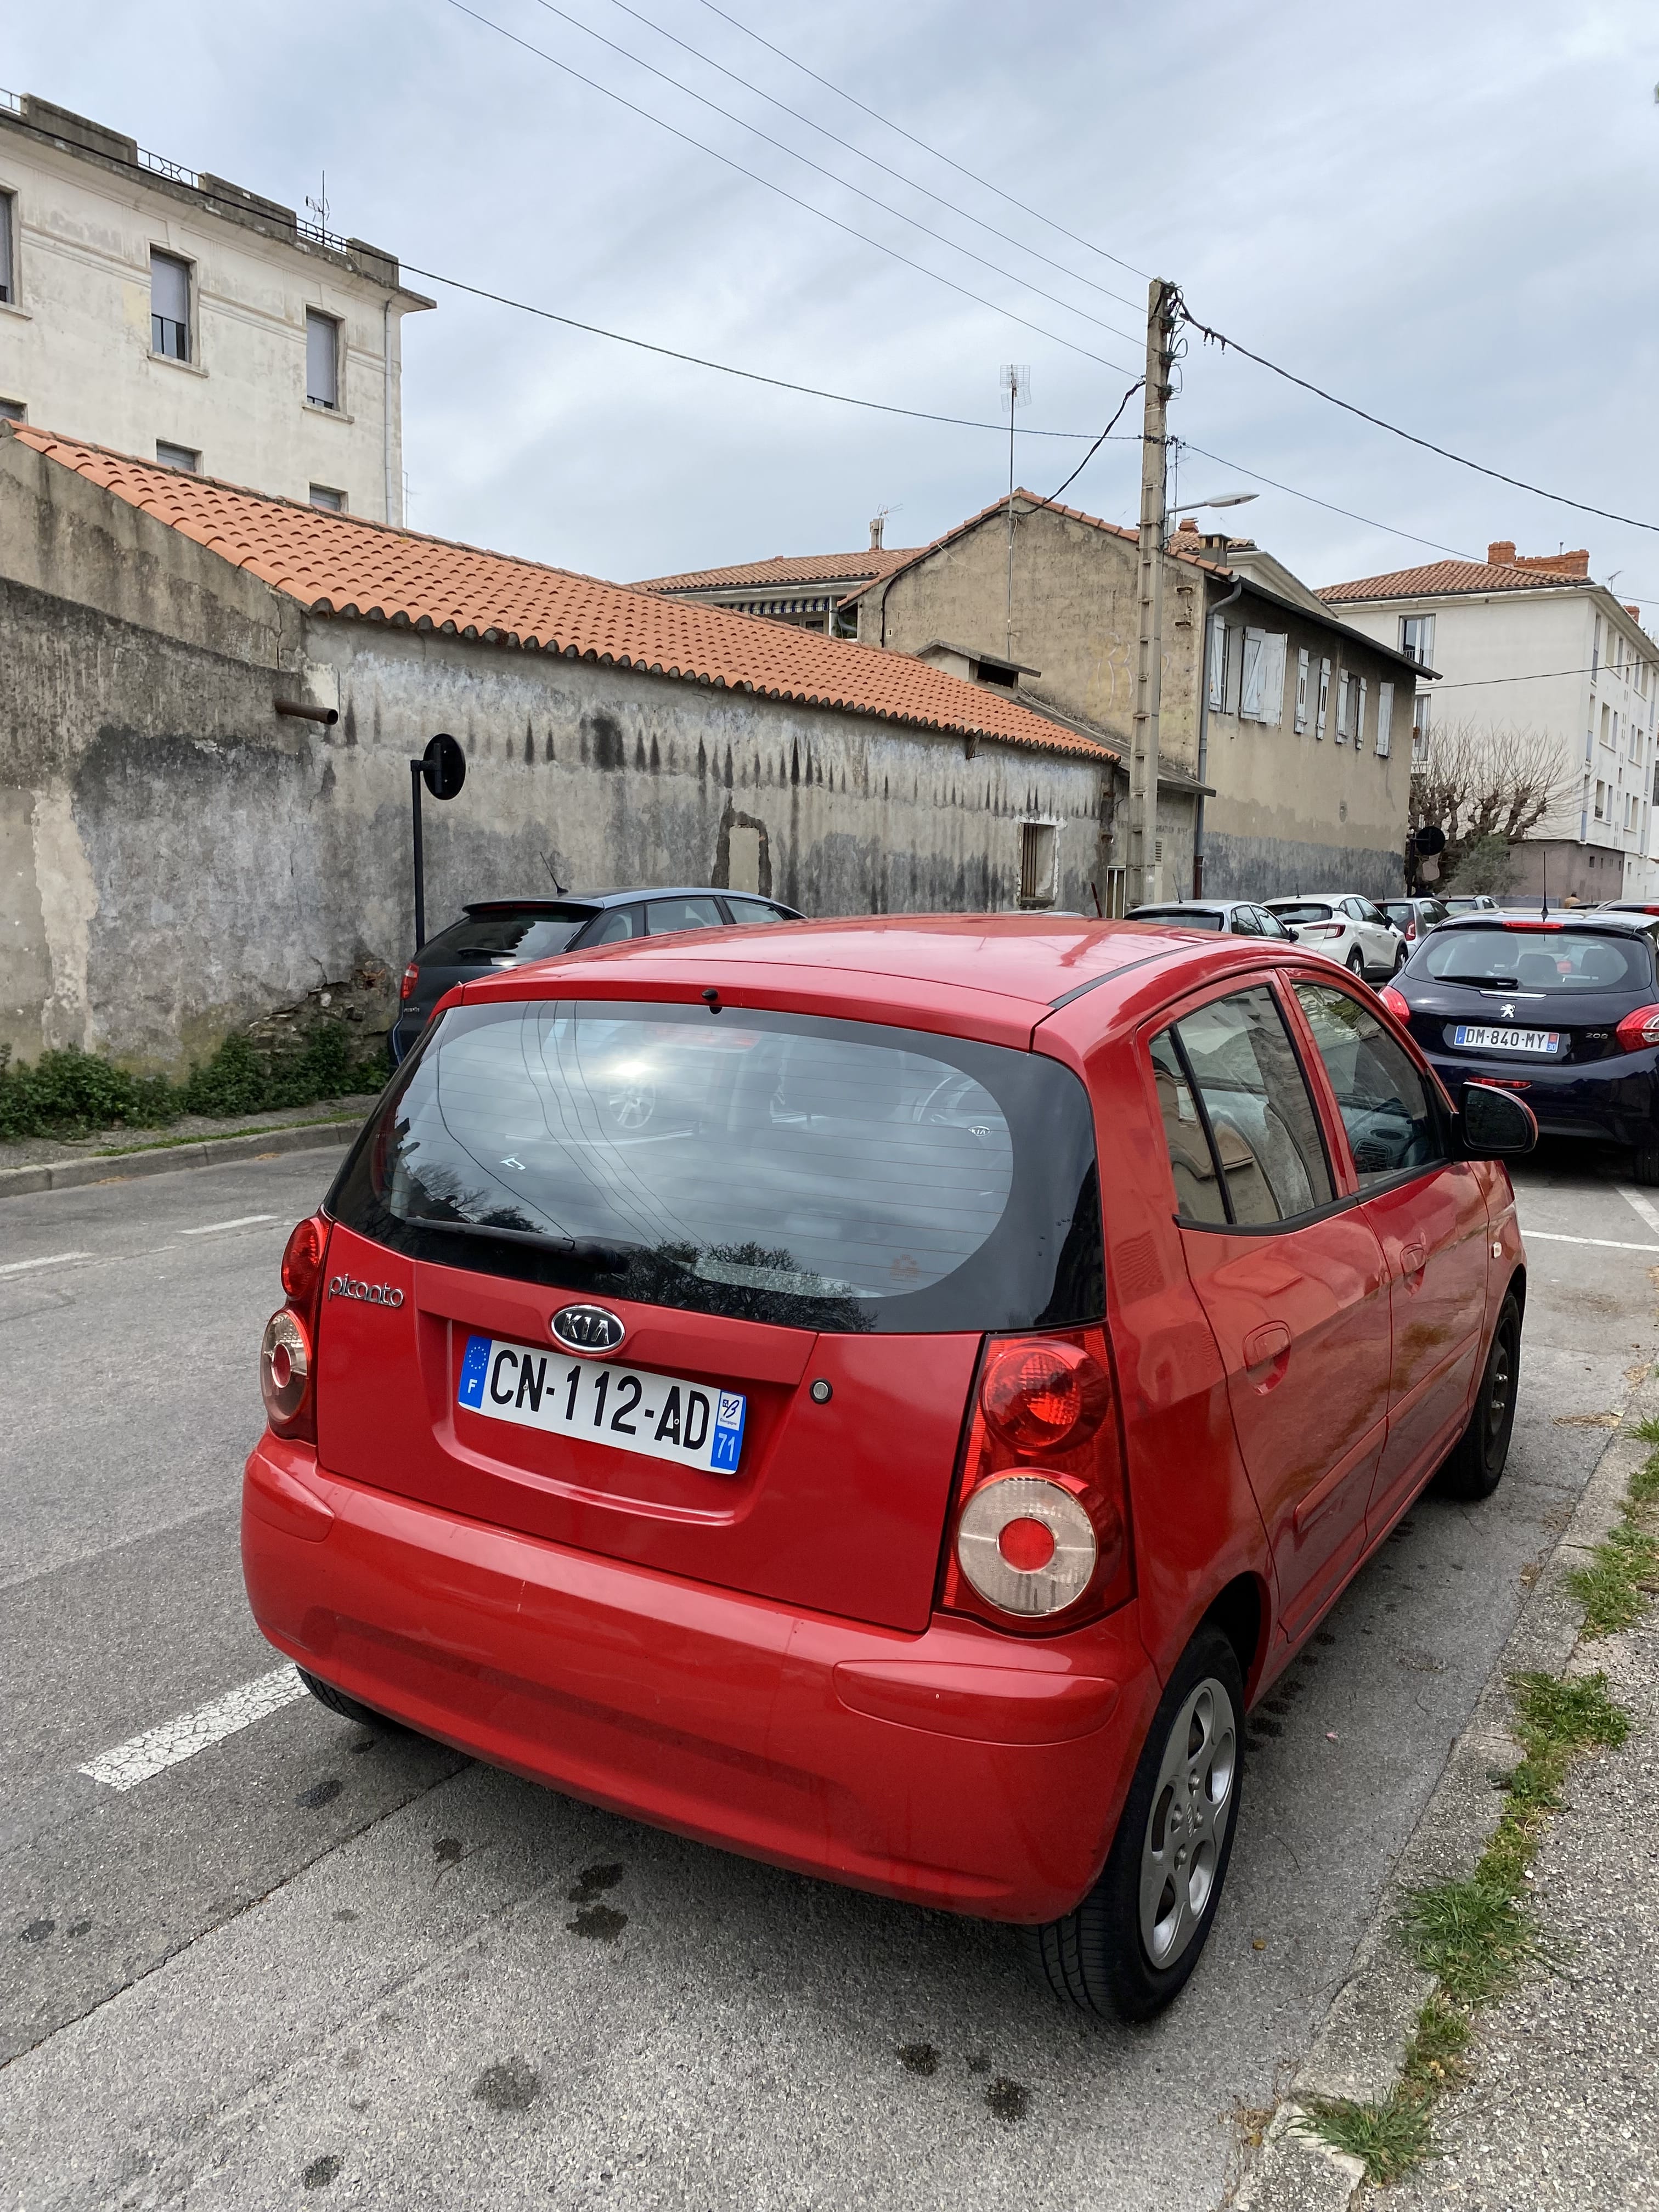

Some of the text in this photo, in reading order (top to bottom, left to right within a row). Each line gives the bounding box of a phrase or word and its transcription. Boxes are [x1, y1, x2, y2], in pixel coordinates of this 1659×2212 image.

[1465, 1029, 1545, 1049] DM-840-MY
[328, 1273, 404, 1308] picanto
[562, 1313, 610, 1345] KIA
[467, 1379, 477, 1393] F
[490, 1350, 710, 1450] CN-112-AD
[718, 1432, 735, 1462] 71
